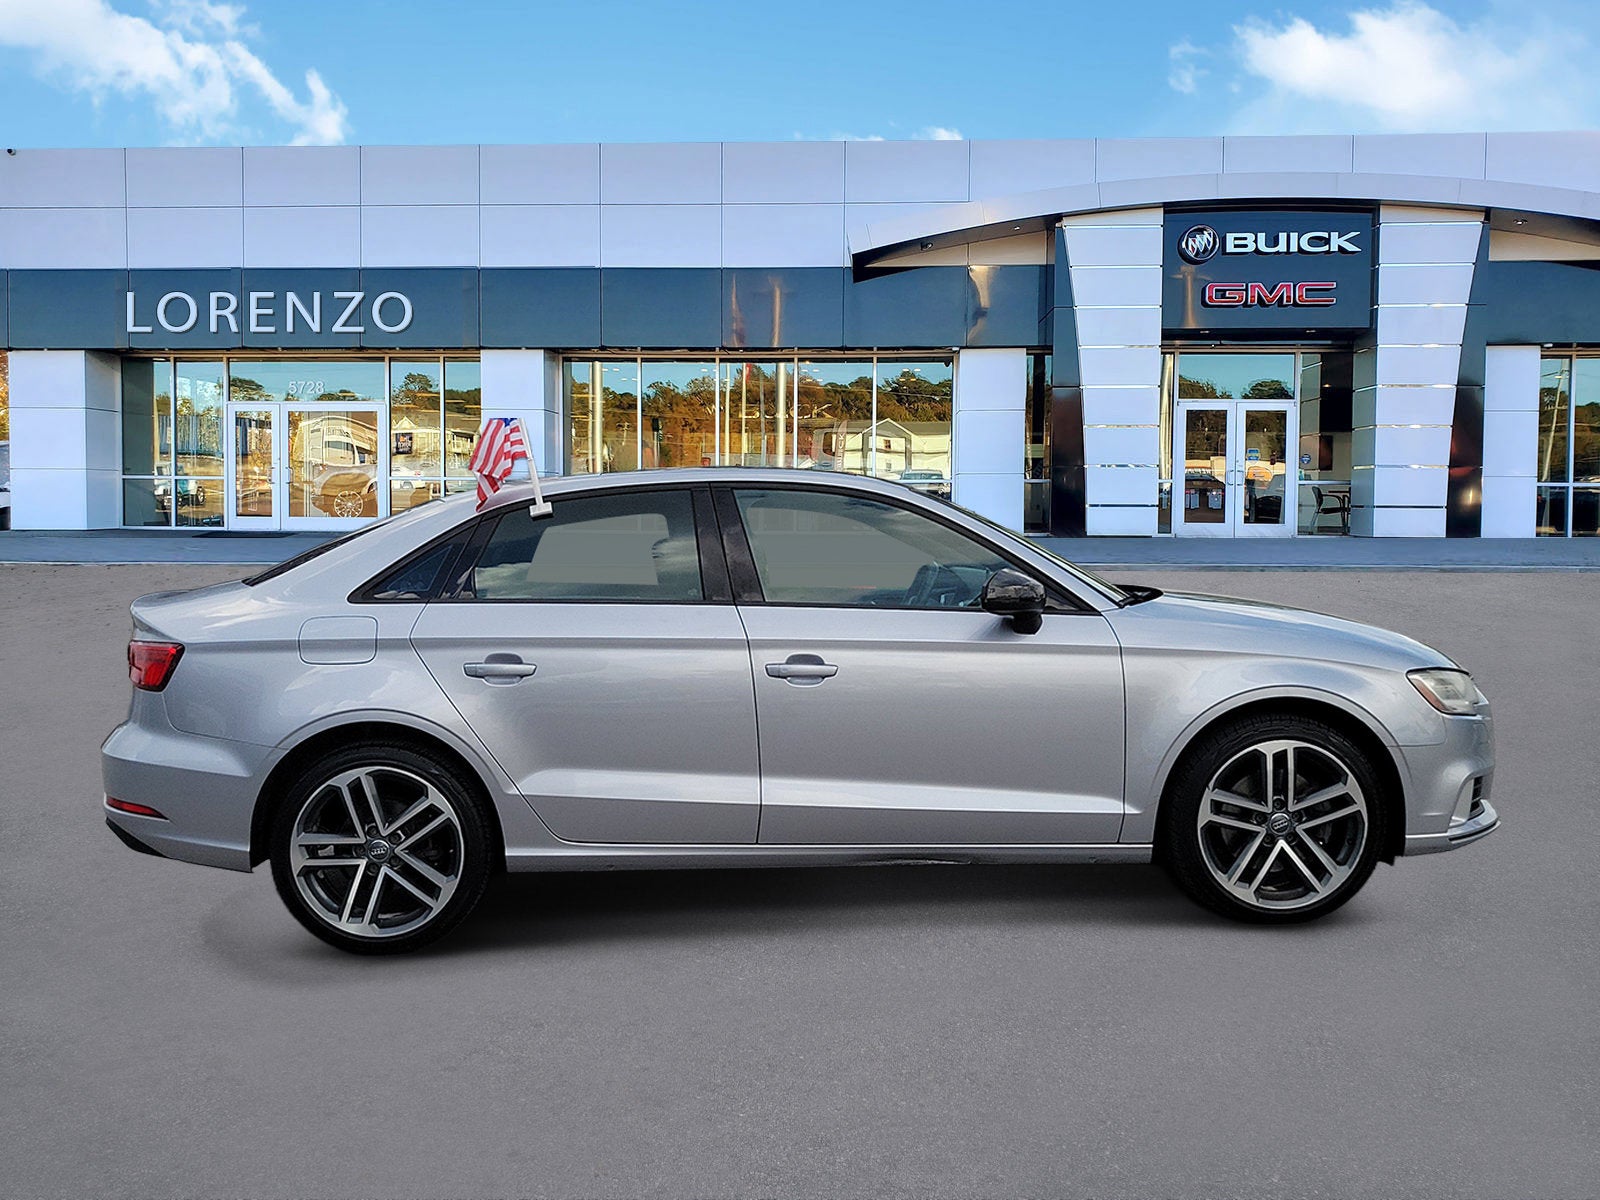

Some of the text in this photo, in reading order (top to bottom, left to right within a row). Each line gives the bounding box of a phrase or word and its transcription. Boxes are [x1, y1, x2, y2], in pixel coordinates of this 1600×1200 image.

[1225, 231, 1362, 252] BUICK
[1205, 281, 1337, 305] GMC
[126, 291, 414, 334] LORENZO
[288, 380, 325, 395] 5728
